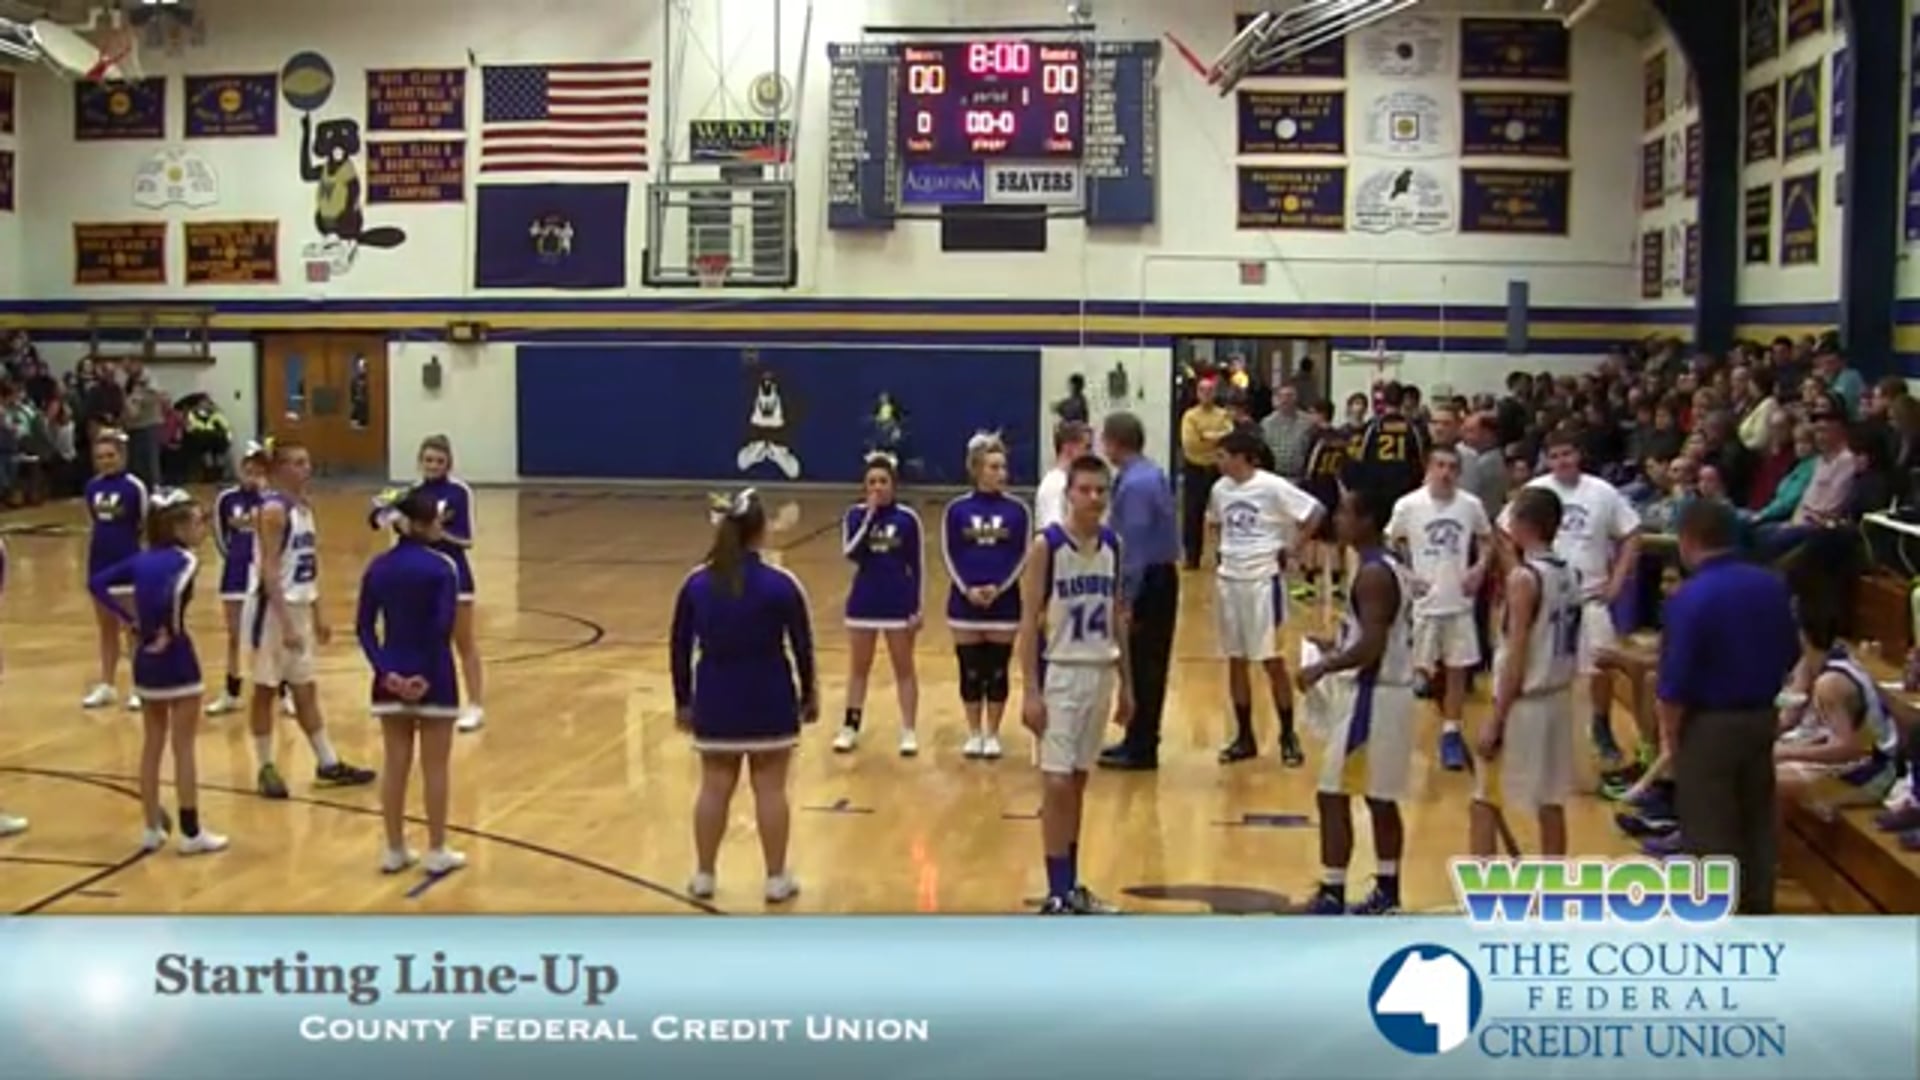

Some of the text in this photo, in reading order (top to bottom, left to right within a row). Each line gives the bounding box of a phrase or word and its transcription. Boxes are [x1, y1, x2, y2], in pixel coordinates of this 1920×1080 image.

[969, 43, 1030, 73] 8:00
[909, 65, 944, 94] 00
[1043, 65, 1078, 94] 00
[917, 111, 931, 134] 0
[1055, 111, 1069, 134] 0
[996, 171, 1074, 192] BEAVERS
[1388, 434, 1416, 461] 21
[1069, 601, 1108, 642] 14
